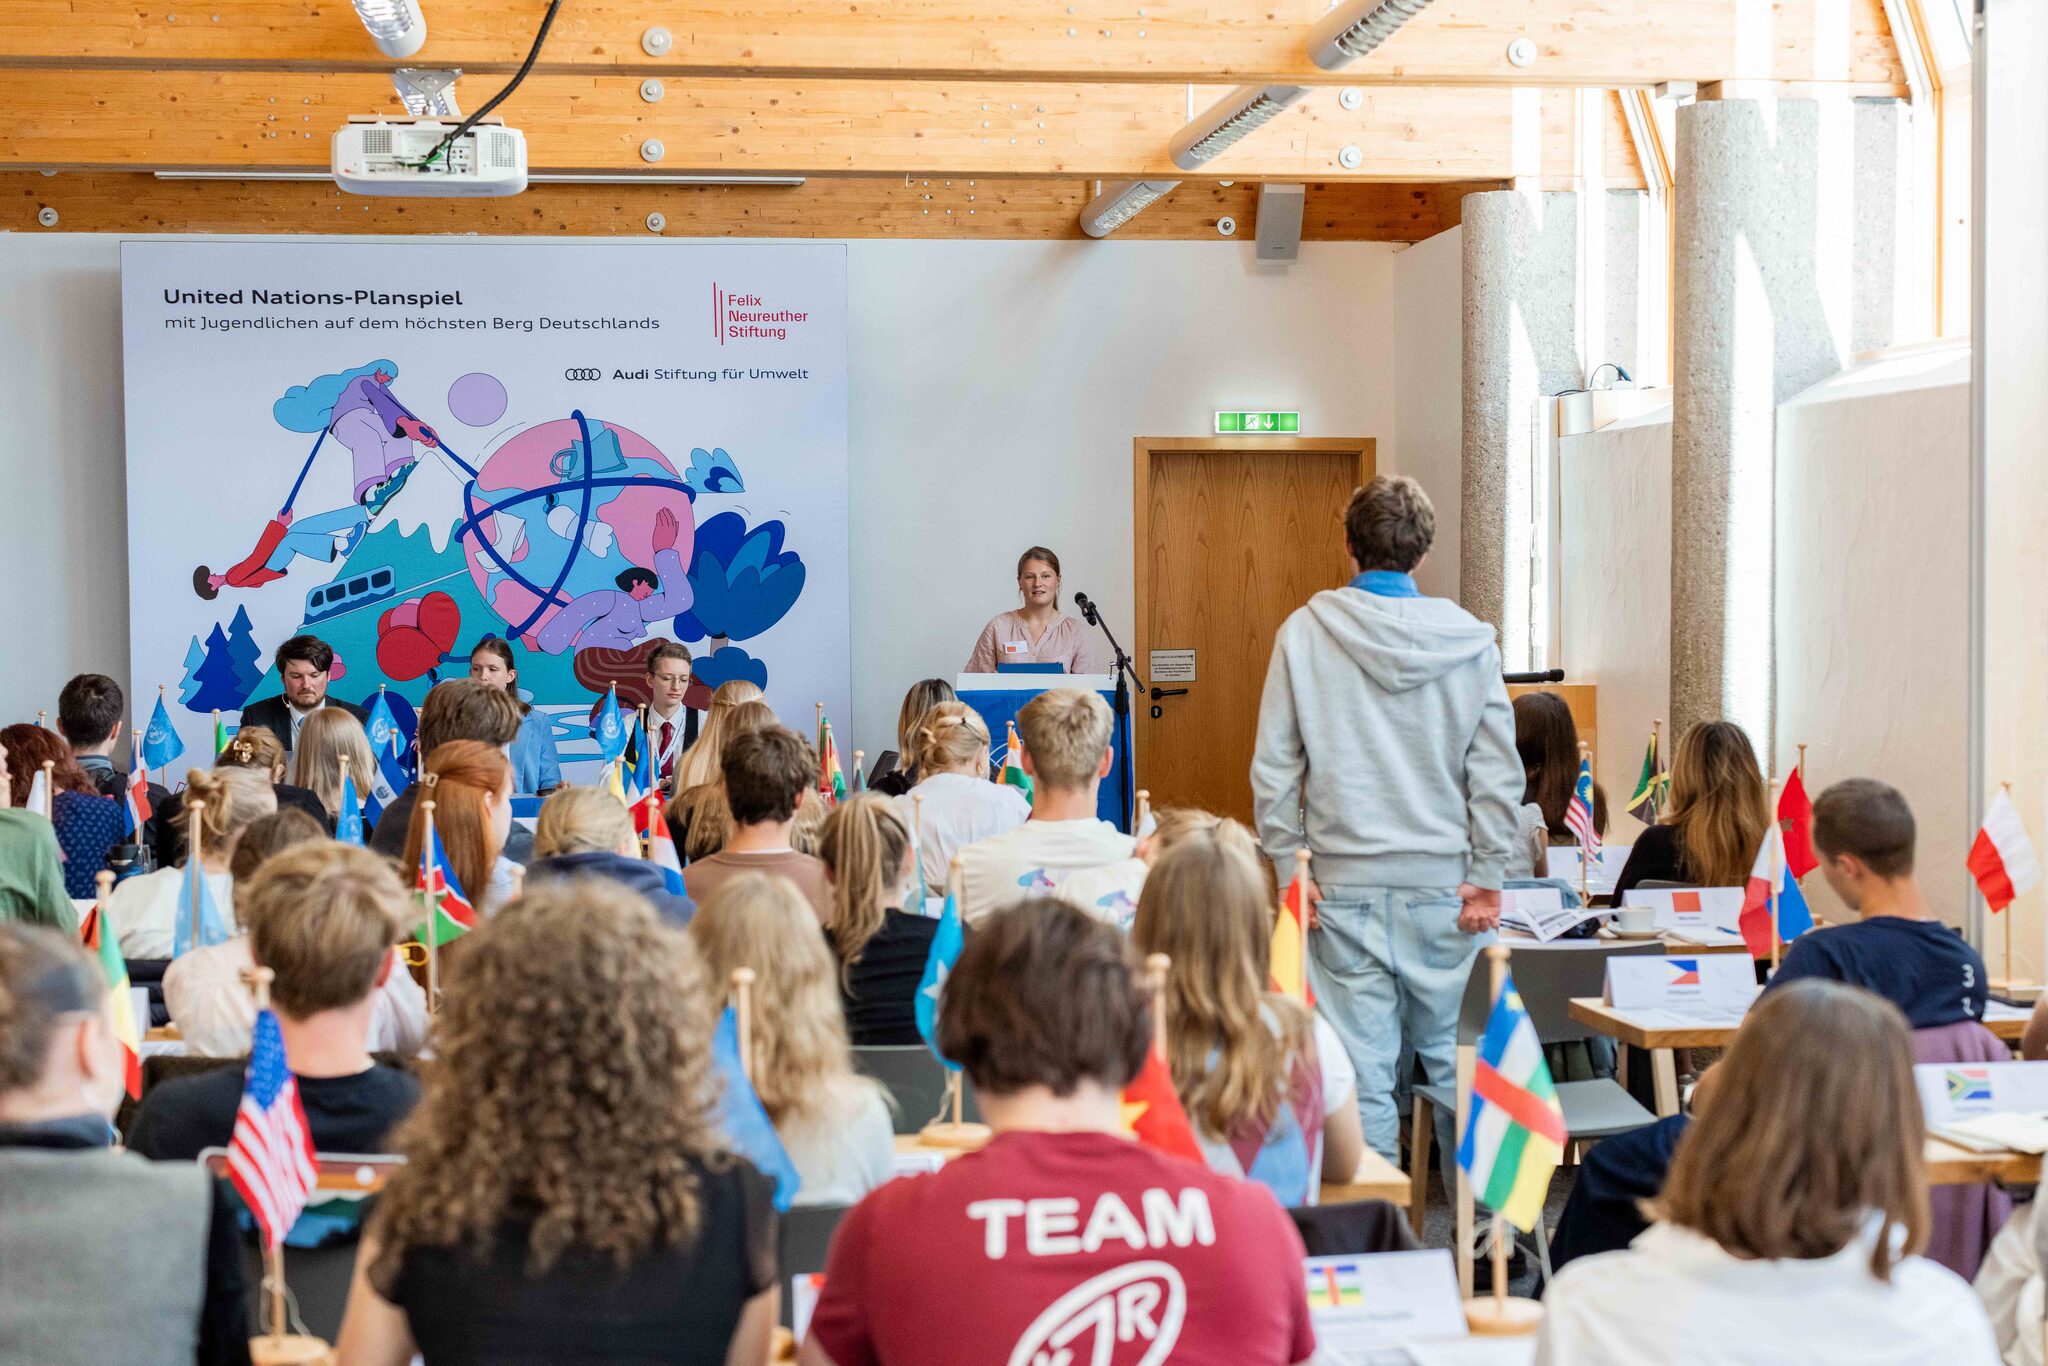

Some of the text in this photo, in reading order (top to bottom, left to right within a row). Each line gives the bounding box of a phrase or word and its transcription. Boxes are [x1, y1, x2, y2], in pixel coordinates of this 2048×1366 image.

[163, 288, 464, 309] United Nations-Planspiel
[727, 293, 762, 307] Felix
[728, 309, 809, 323] Neureuther
[164, 316, 660, 333] mit Jugendlichen auf dem höchsten Berg Deutschlands
[728, 325, 786, 341] Stiftung
[611, 367, 809, 383] Audi Stiftung für Umwelt
[965, 1186, 1217, 1261] TEAM
